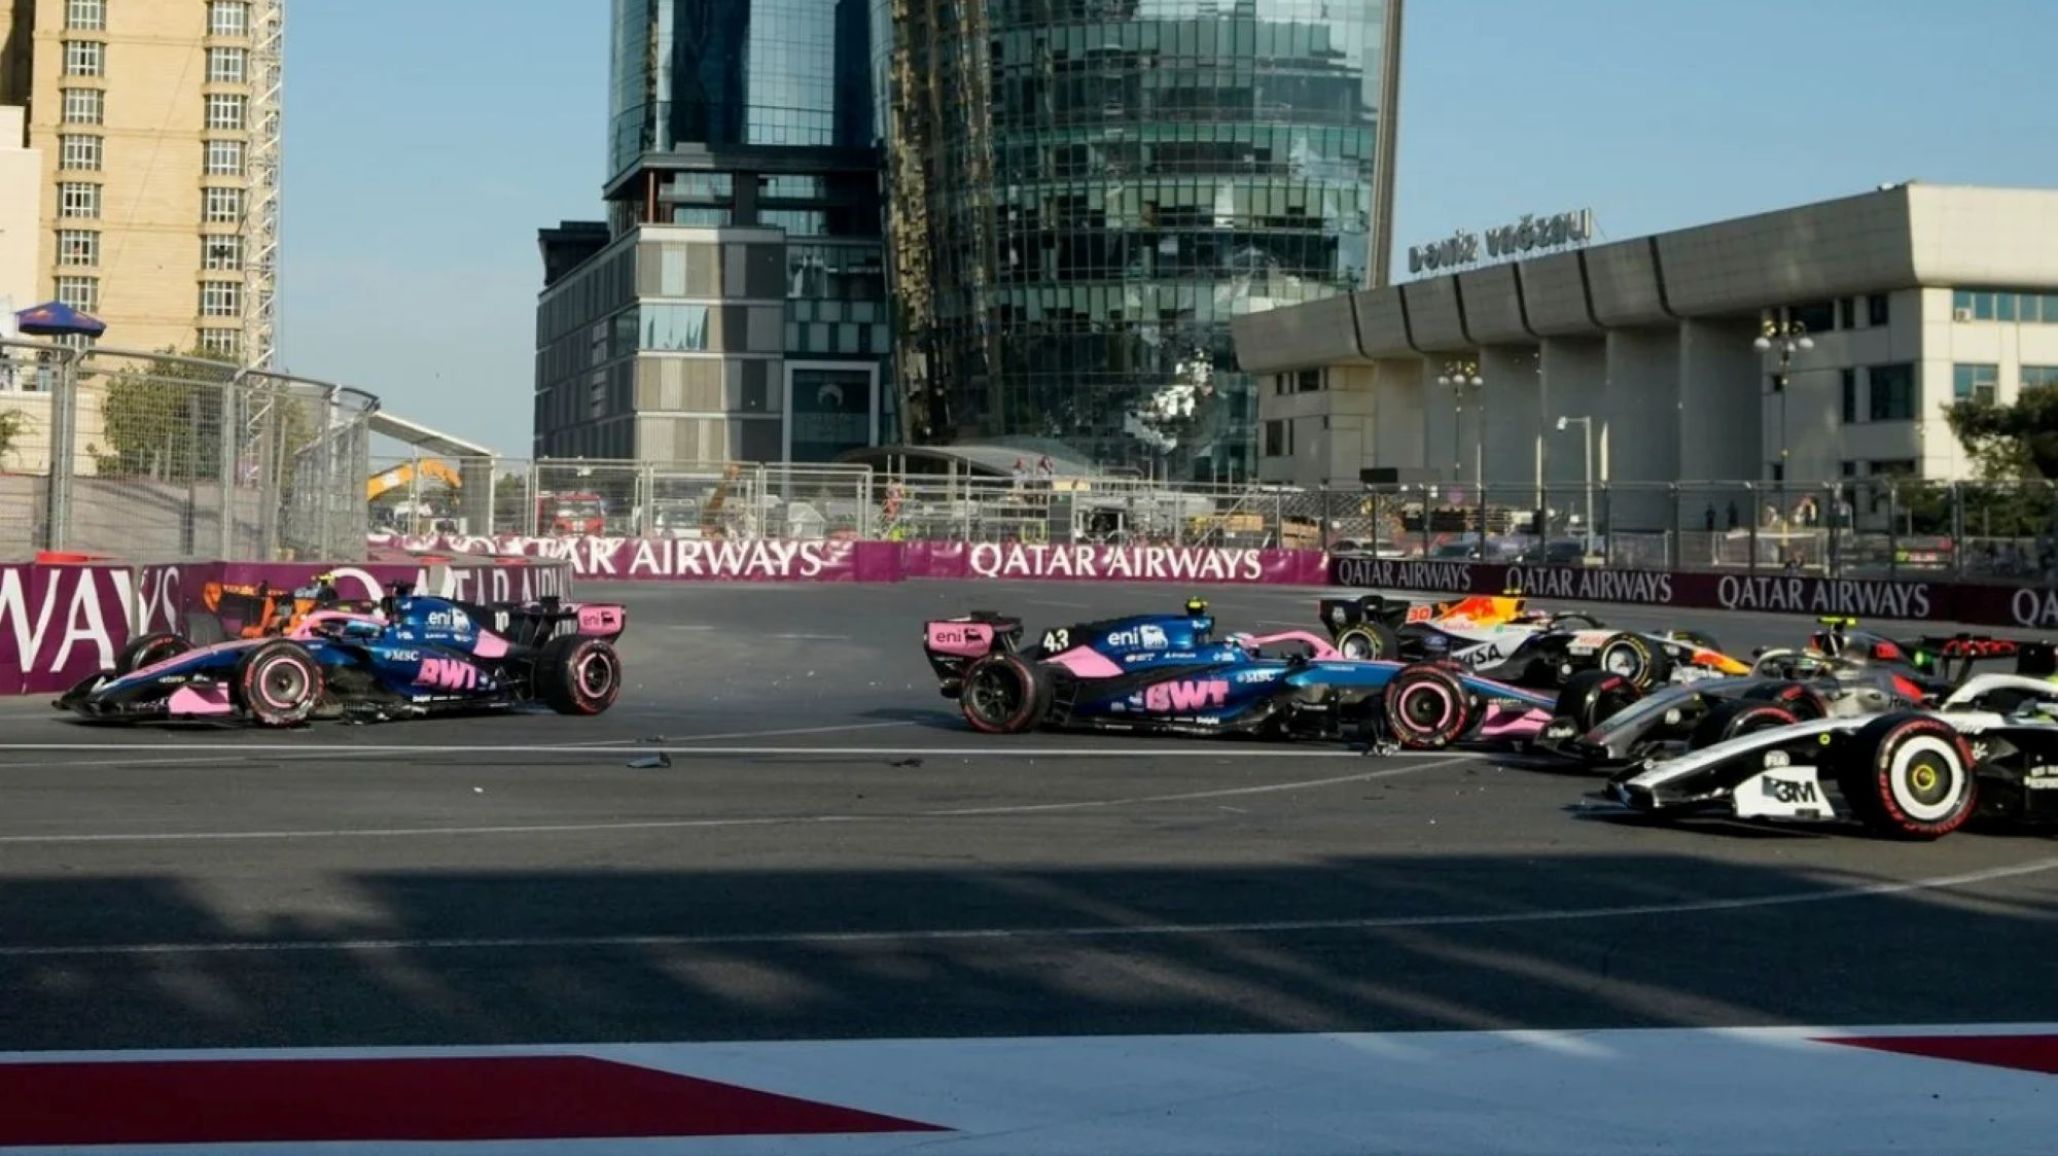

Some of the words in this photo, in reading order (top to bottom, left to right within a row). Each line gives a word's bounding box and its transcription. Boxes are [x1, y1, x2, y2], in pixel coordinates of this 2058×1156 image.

[629, 540, 825, 577] AIRWAYS
[969, 542, 1097, 577] QATAR
[1106, 546, 1263, 580] AIRWAYS
[1338, 559, 1394, 587] QATAR
[1397, 563, 1472, 592] AIRWAYS
[1505, 565, 1575, 598] QATAR
[1578, 568, 1673, 602] AIRWAYS
[1717, 574, 1804, 611] QATAR
[1810, 580, 1930, 618] AIRWAYS
[428, 607, 451, 625] eni
[582, 612, 600, 626] eni
[935, 630, 962, 643] eni
[1043, 629, 1069, 652] 43
[1107, 626, 1139, 646] eni
[1146, 680, 1229, 712] BWT
[1772, 778, 1818, 803] 3M
